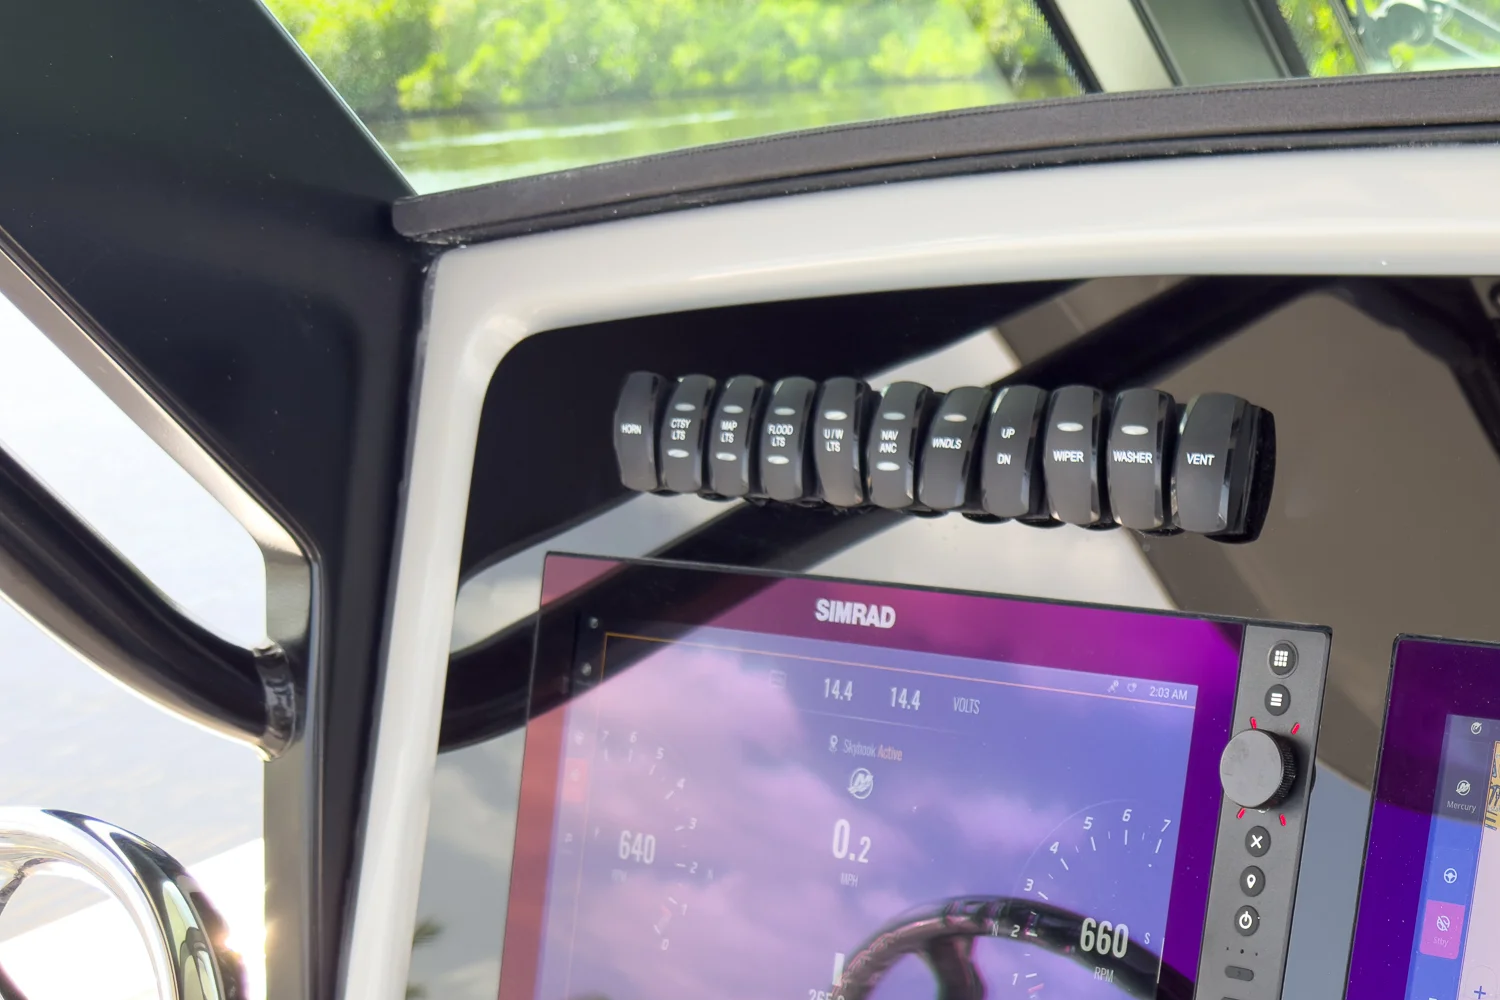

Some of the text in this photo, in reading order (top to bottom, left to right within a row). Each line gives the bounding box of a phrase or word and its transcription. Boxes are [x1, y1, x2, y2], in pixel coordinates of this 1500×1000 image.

[621, 424, 642, 435] HORN
[671, 418, 691, 429] CTSY
[721, 420, 738, 431] MAP
[767, 424, 794, 436] FLOOD
[672, 429, 686, 441] LTS
[720, 432, 734, 443] LTS
[881, 429, 899, 441] NAV
[1001, 428, 1016, 439] UP
[772, 436, 786, 447] LTS
[826, 441, 841, 453] LTS
[879, 442, 898, 454] ANC
[932, 437, 962, 450] WNDLS
[997, 454, 1011, 465] DN
[1053, 451, 1085, 463] WIPER
[1113, 451, 1153, 464] WASHER
[1186, 453, 1215, 466] VENT
[815, 598, 896, 628] SIMRAD
[824, 678, 980, 715] 14.4 14.4 VOLTS
[1150, 686, 1188, 700] 2:03 AM
[1446, 800, 1477, 813] Mercury
[1122, 809, 1132, 822] 6
[1083, 816, 1094, 830] 5
[1161, 819, 1171, 833] 7
[619, 830, 656, 865] 640
[832, 818, 871, 864] 0.2
[1050, 841, 1060, 855] 4
[1024, 879, 1034, 892] 3
[1011, 925, 1020, 938] 2
[1080, 917, 1130, 959] 660
[1433, 936, 1449, 947] Stby
[1094, 966, 1114, 984] RPM
